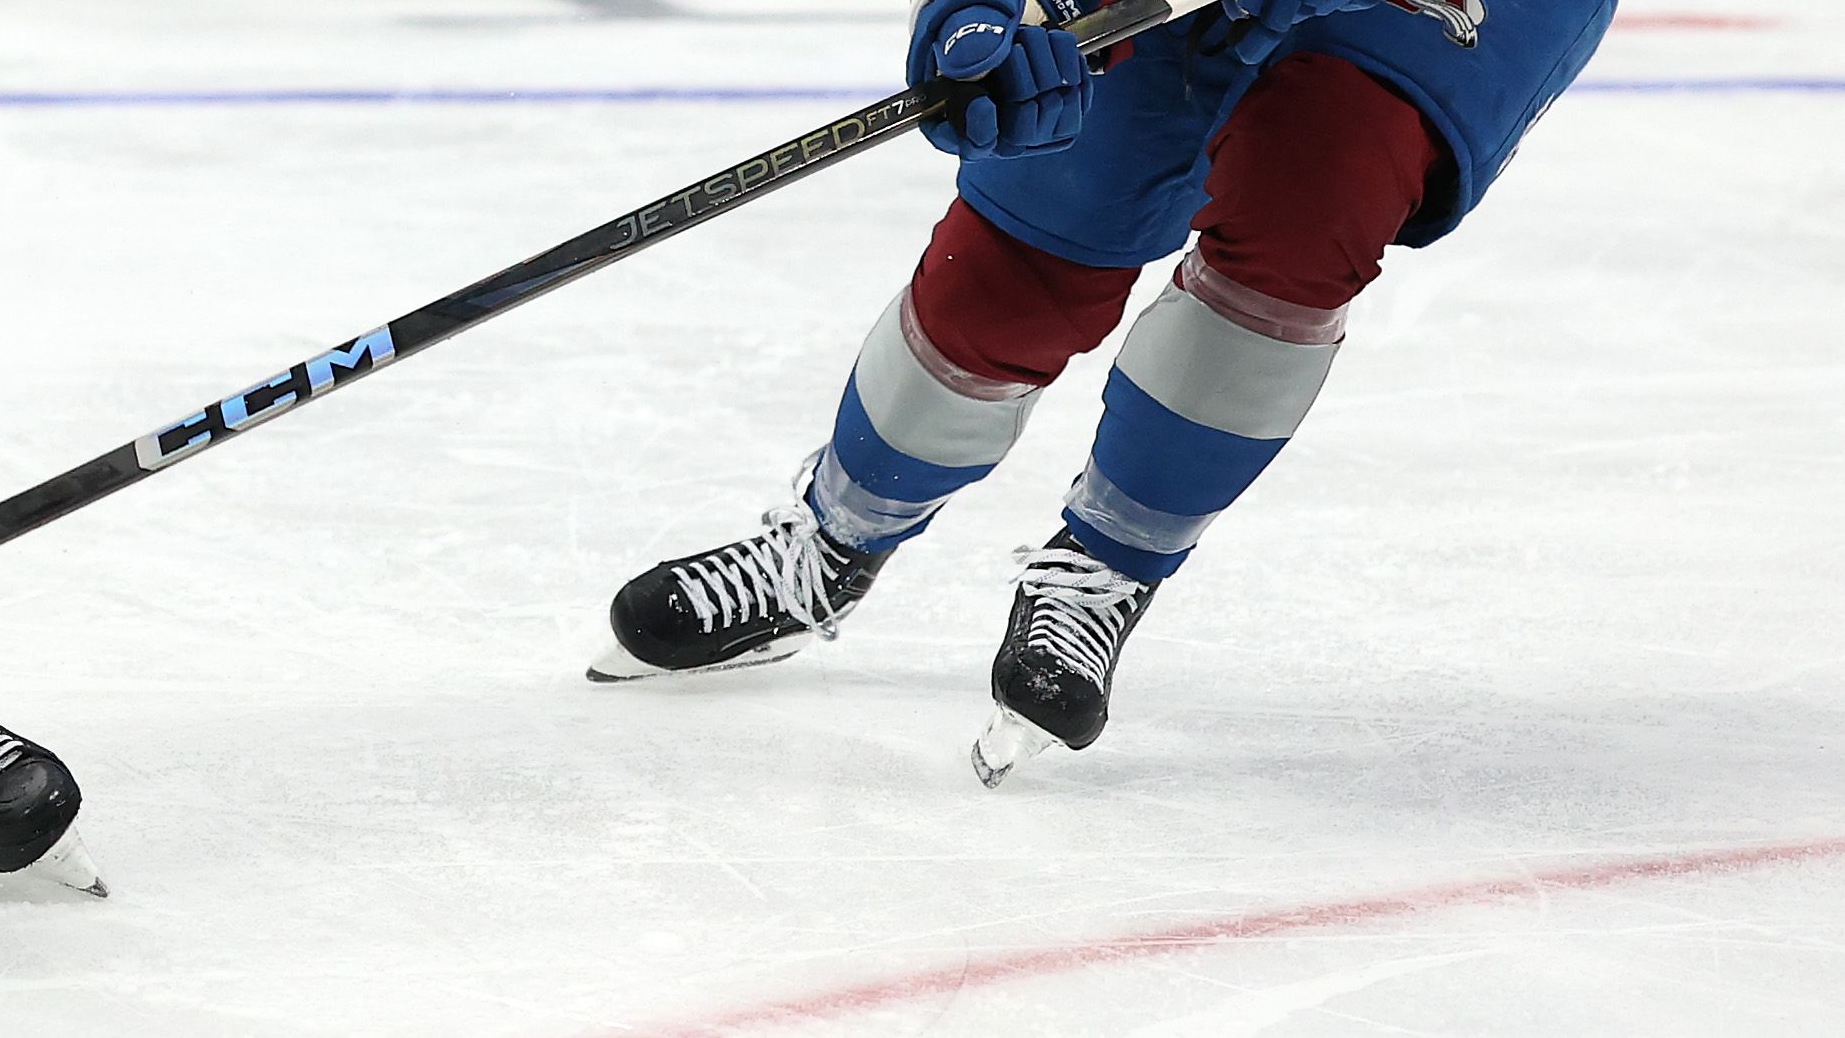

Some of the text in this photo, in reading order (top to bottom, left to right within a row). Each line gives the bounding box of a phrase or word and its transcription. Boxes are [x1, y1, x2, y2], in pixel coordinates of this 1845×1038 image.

[944, 22, 1004, 55] CCM
[609, 117, 867, 251] JETSPEED
[134, 323, 395, 471] CCM
